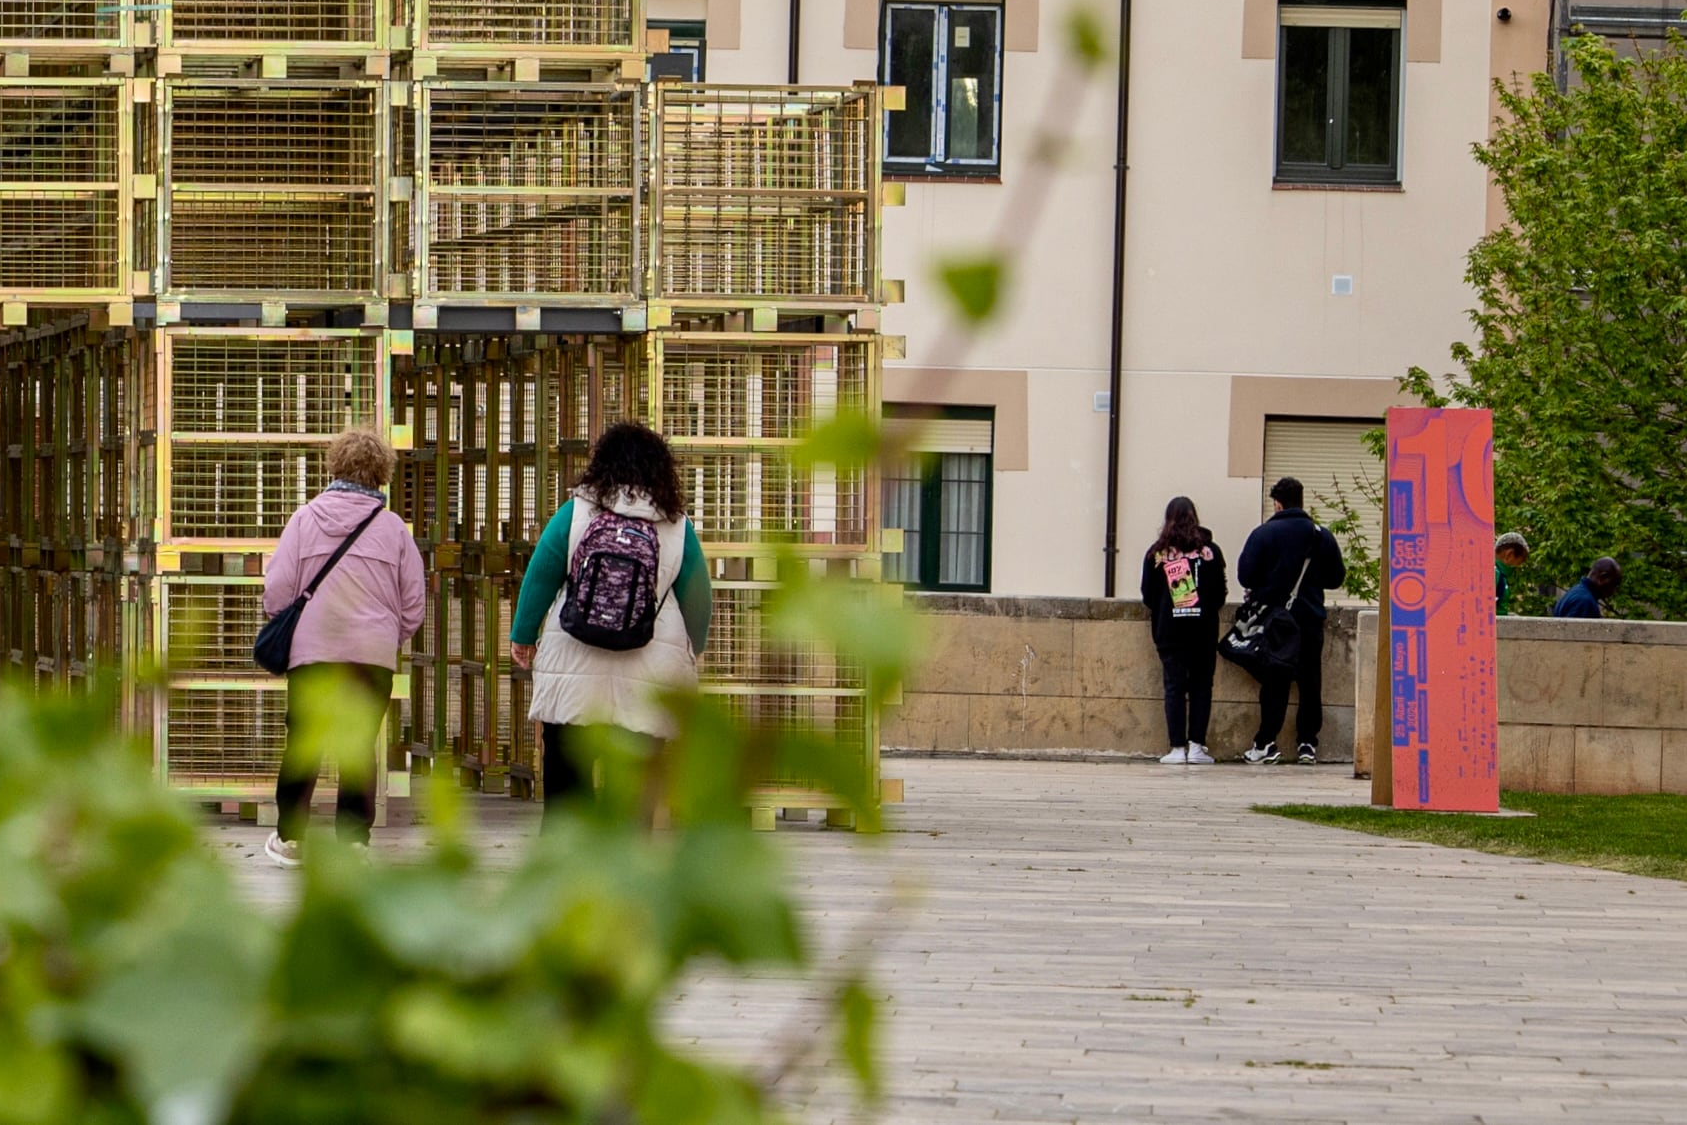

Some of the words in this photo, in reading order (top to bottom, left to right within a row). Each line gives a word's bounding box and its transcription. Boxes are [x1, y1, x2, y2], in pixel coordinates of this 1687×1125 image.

[1392, 539, 1404, 569] Con
[1394, 642, 1407, 671] Mayo
[1395, 697, 1405, 721] Abril
